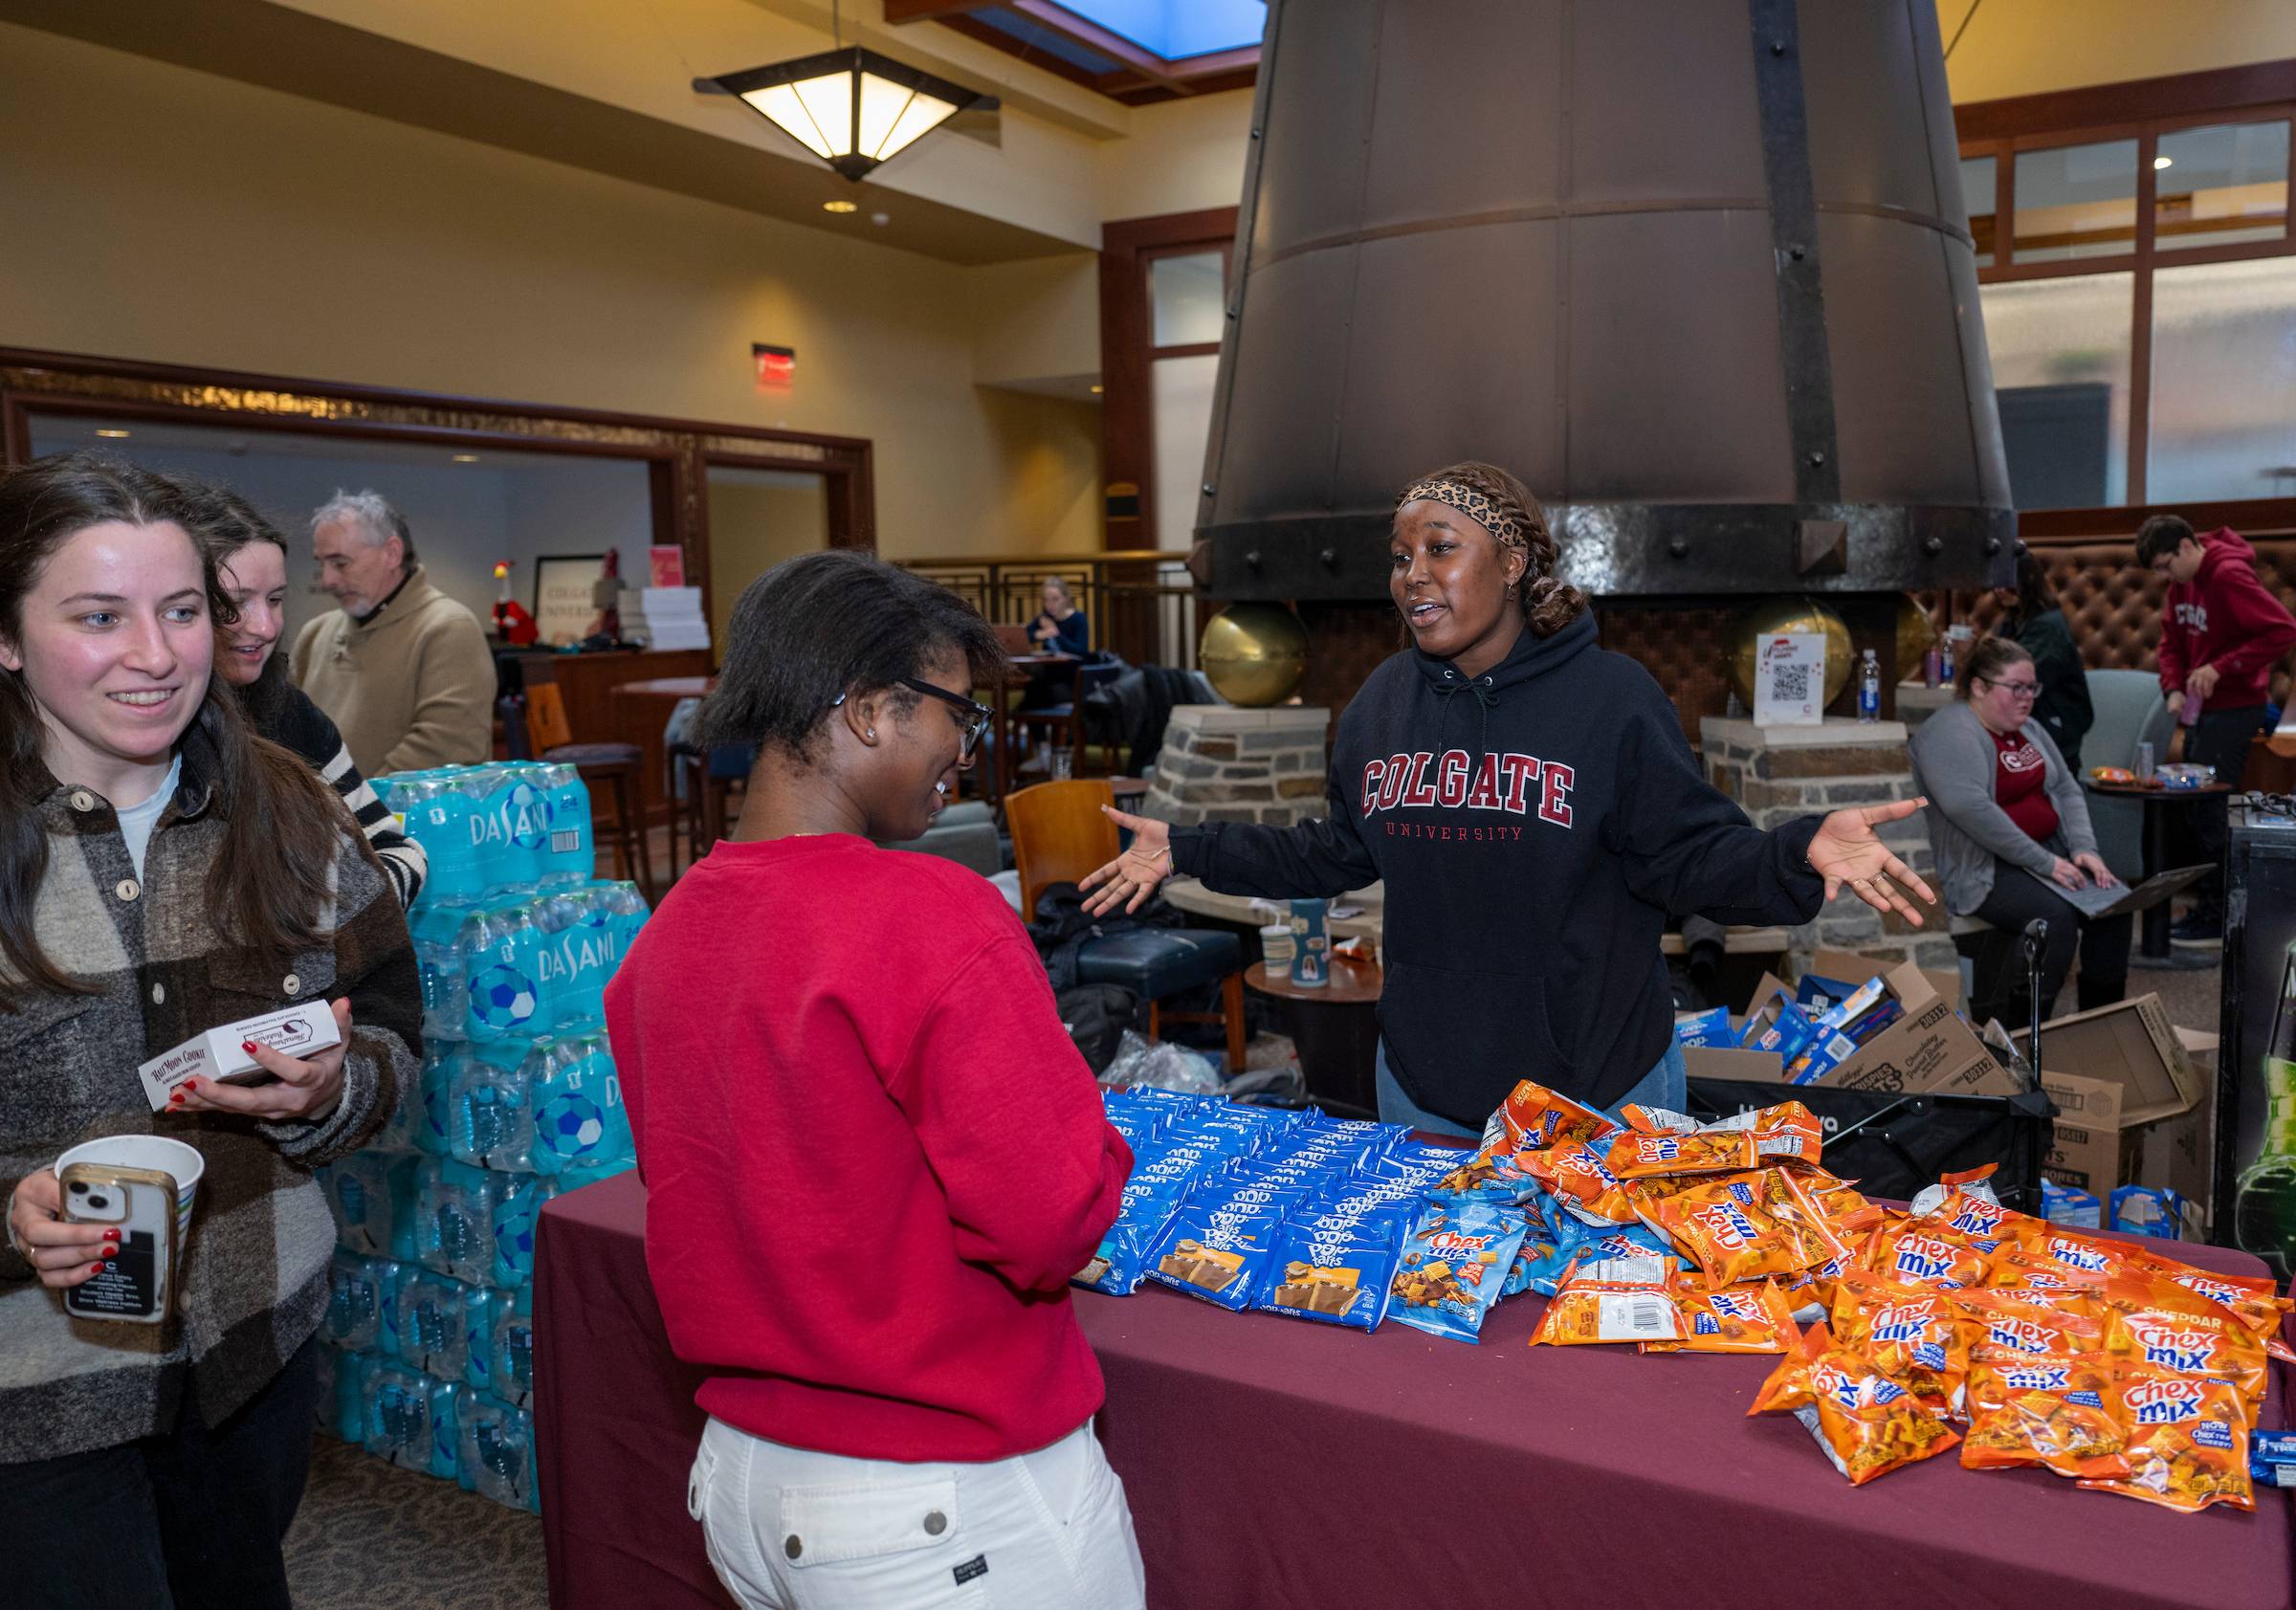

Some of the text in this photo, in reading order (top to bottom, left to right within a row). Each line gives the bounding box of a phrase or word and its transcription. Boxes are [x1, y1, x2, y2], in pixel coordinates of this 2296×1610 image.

[1361, 750, 1575, 828] COLGATE
[560, 795, 578, 811] 24
[470, 800, 547, 848] DASANI
[1385, 822, 1523, 842] UNIVERSITY
[538, 934, 614, 982] DASANI
[1919, 1004, 1949, 1028] 30312
[1964, 1059, 1993, 1083] 30312
[1959, 1197, 2009, 1220] Chex
[1694, 1208, 1743, 1249] Chex
[1952, 1212, 1998, 1235] mix
[1431, 1231, 1492, 1248] Chex
[1896, 1235, 1958, 1261] Chex
[1898, 1252, 1953, 1277] mix
[2055, 1249, 2109, 1271] mix
[1873, 1299, 1933, 1329] Chex
[1873, 1317, 1931, 1340] mix
[1997, 1320, 2057, 1341] hex
[2136, 1327, 2219, 1349] Chex
[1924, 1343, 1945, 1355] NOW
[2147, 1347, 2210, 1371] mix
[2009, 1371, 2067, 1389] mix
[2126, 1380, 2202, 1406] Chex
[2138, 1399, 2199, 1422] mix
[2202, 1423, 2229, 1431] NOW
[2197, 1438, 2233, 1448] CHEESY!
